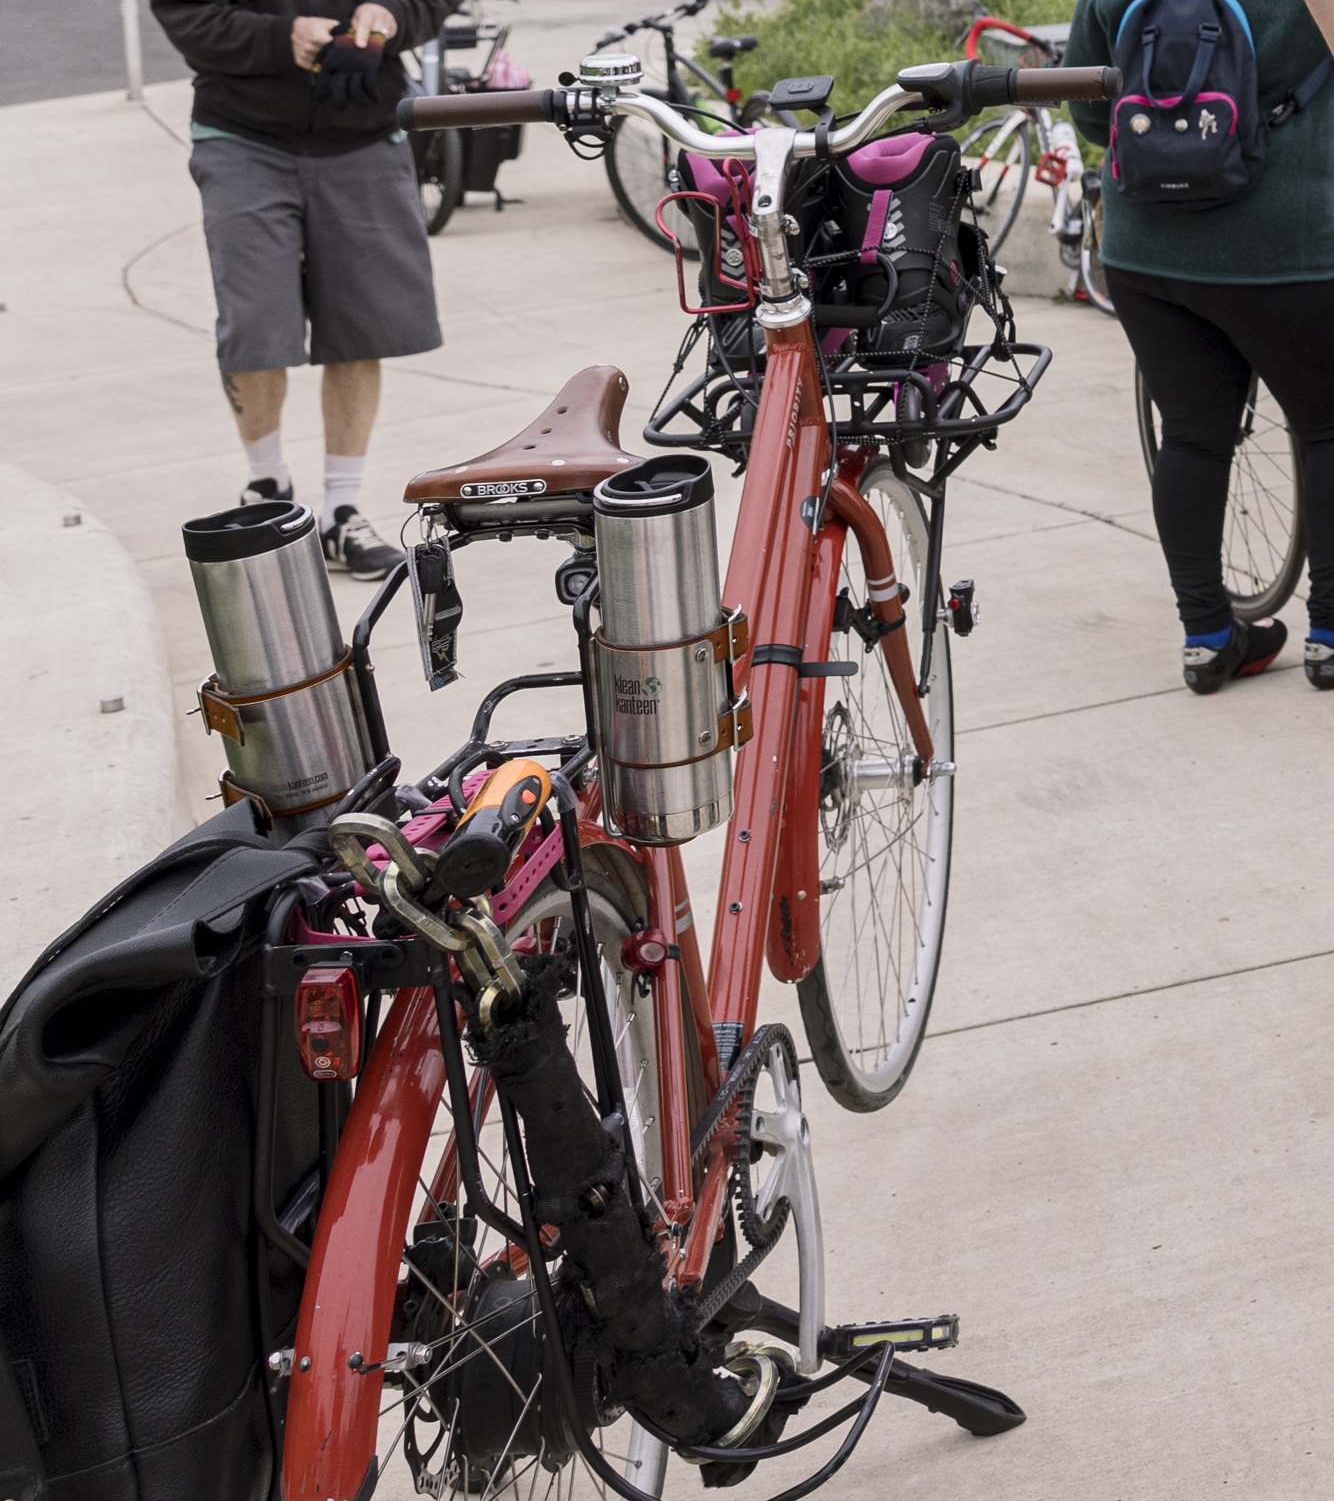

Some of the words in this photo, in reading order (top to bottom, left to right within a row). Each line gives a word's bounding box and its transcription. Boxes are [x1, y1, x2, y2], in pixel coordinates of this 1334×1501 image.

[785, 376, 804, 450] PRIORITY
[477, 482, 528, 496] BROOKS
[614, 673, 641, 696] klean
[615, 693, 658, 715] kanteen
